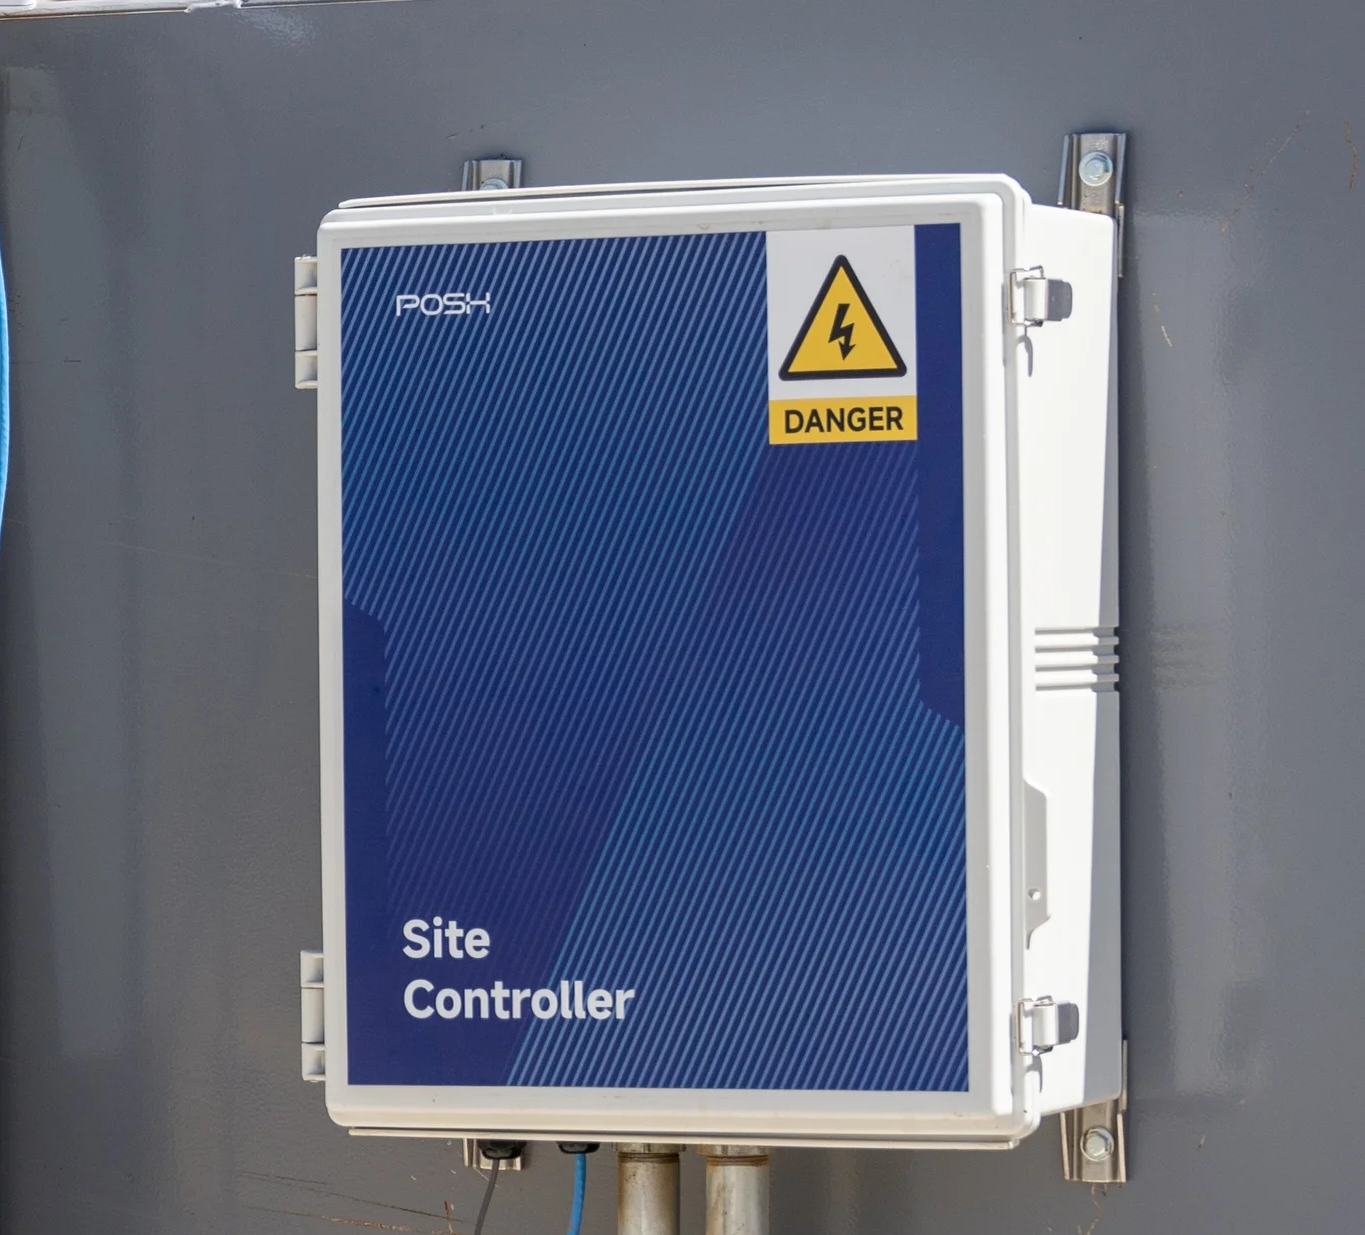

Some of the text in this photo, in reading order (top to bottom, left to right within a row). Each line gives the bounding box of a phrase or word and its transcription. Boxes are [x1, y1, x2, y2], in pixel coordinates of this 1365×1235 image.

[396, 291, 491, 317] POSH
[783, 406, 905, 435] DANGER
[402, 917, 491, 959] Site
[403, 979, 636, 1021] Controller
